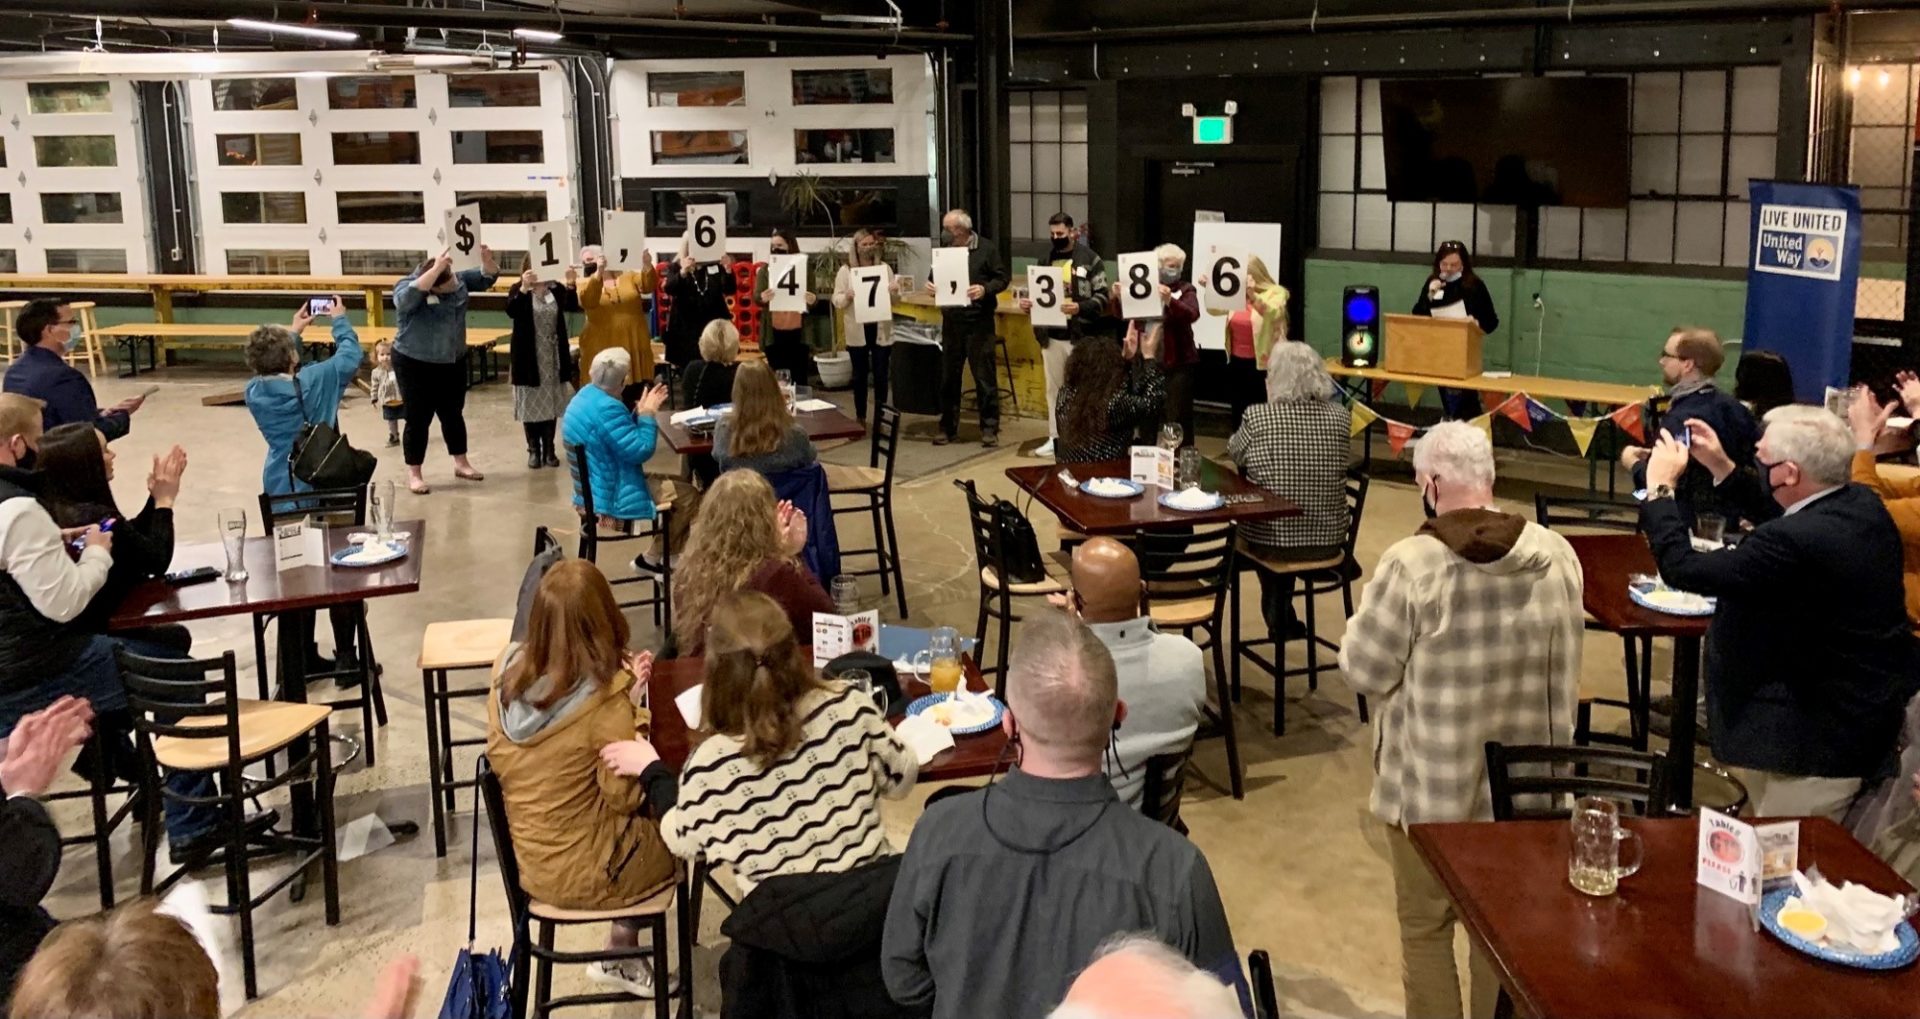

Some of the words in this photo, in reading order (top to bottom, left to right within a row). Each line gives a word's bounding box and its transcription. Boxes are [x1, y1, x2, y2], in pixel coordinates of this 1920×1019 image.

[455, 215, 475, 256] $
[694, 215, 717, 248] 6
[1763, 209, 1788, 228] LIVE
[1793, 211, 1842, 232] UNITED
[539, 231, 560, 267] 1
[1763, 232, 1803, 251] United
[1777, 248, 1802, 269] Way
[776, 265, 800, 296] 4
[861, 275, 881, 308] 7
[1036, 275, 1056, 309] 3
[1128, 263, 1152, 299] 8
[1212, 256, 1241, 297] 6
